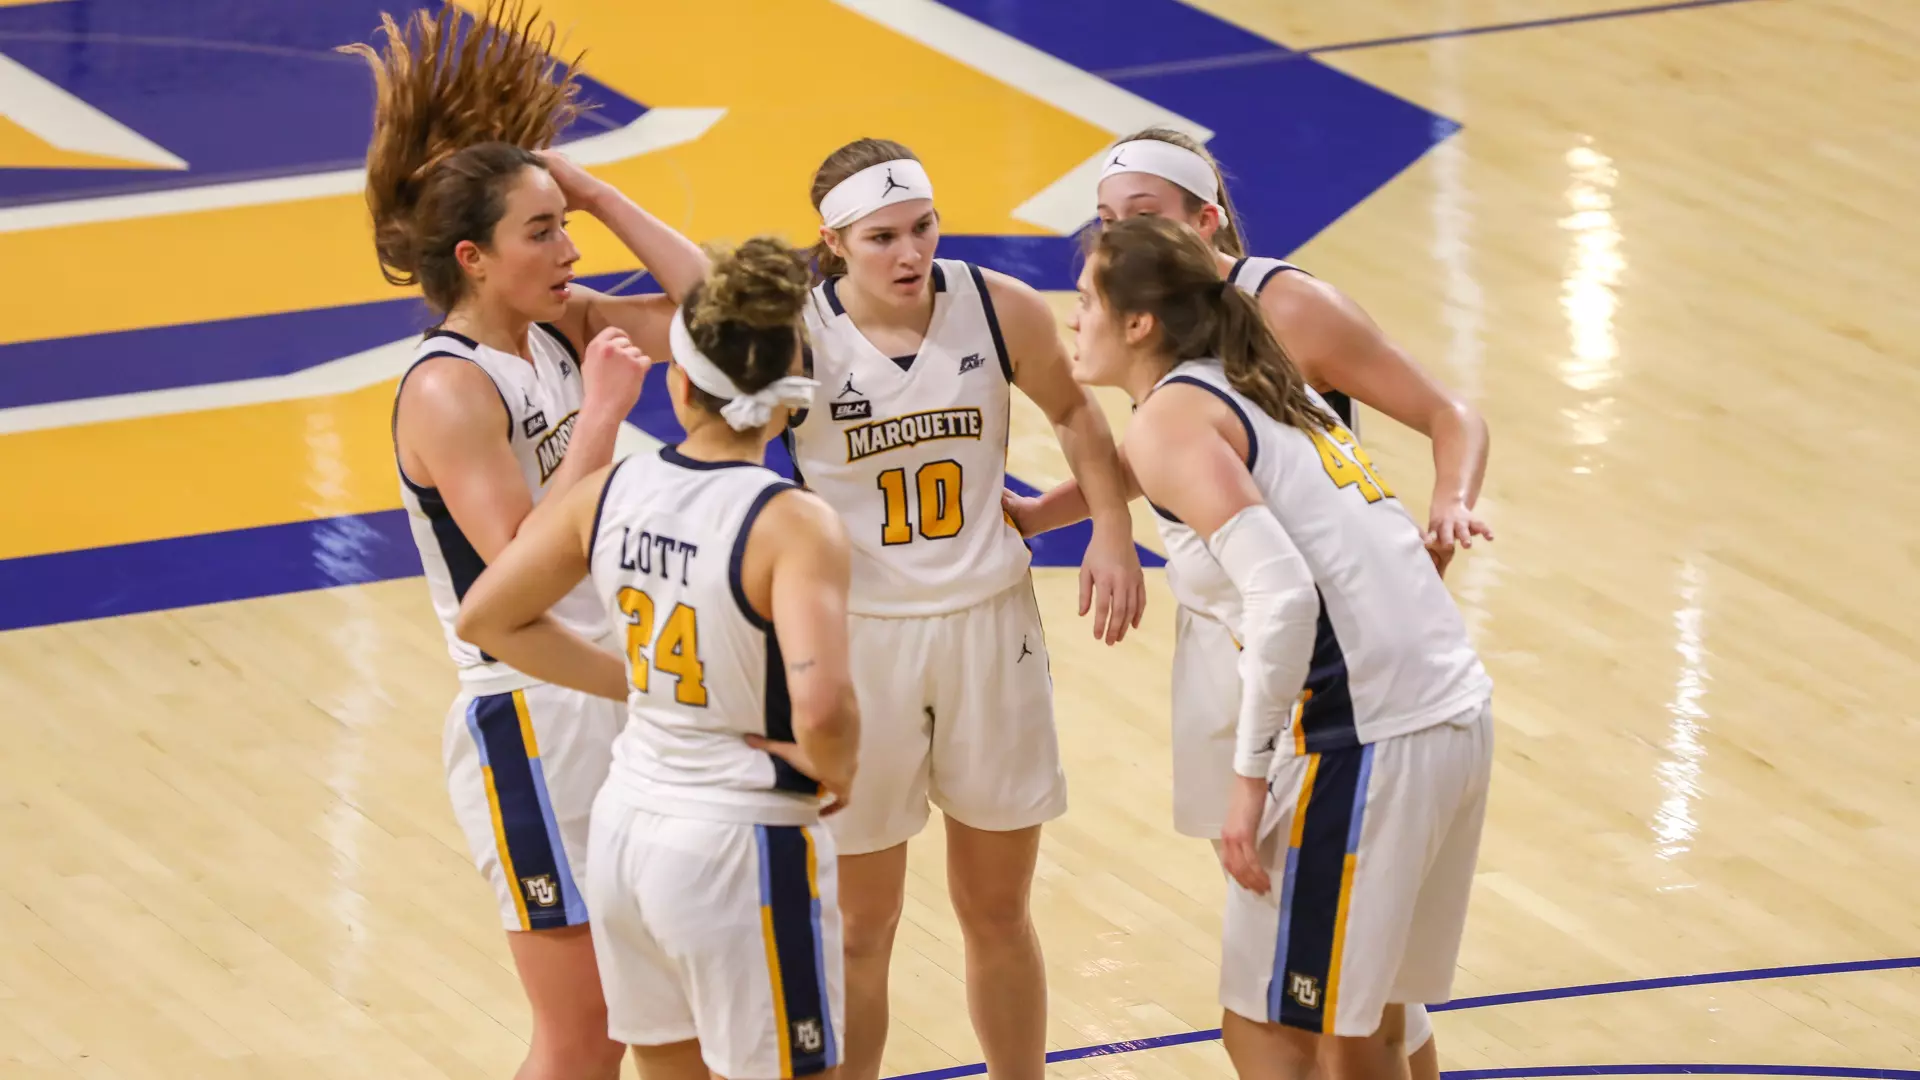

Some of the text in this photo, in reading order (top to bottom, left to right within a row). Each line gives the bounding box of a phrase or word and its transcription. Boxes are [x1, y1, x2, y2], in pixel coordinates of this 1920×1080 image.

[836, 402, 867, 416] BLM
[847, 409, 981, 460] MARQUETTE
[877, 459, 964, 546] 10
[620, 526, 698, 587] LOTT
[616, 586, 708, 708] 24
[523, 875, 556, 906] MU
[1290, 974, 1319, 1008] MU
